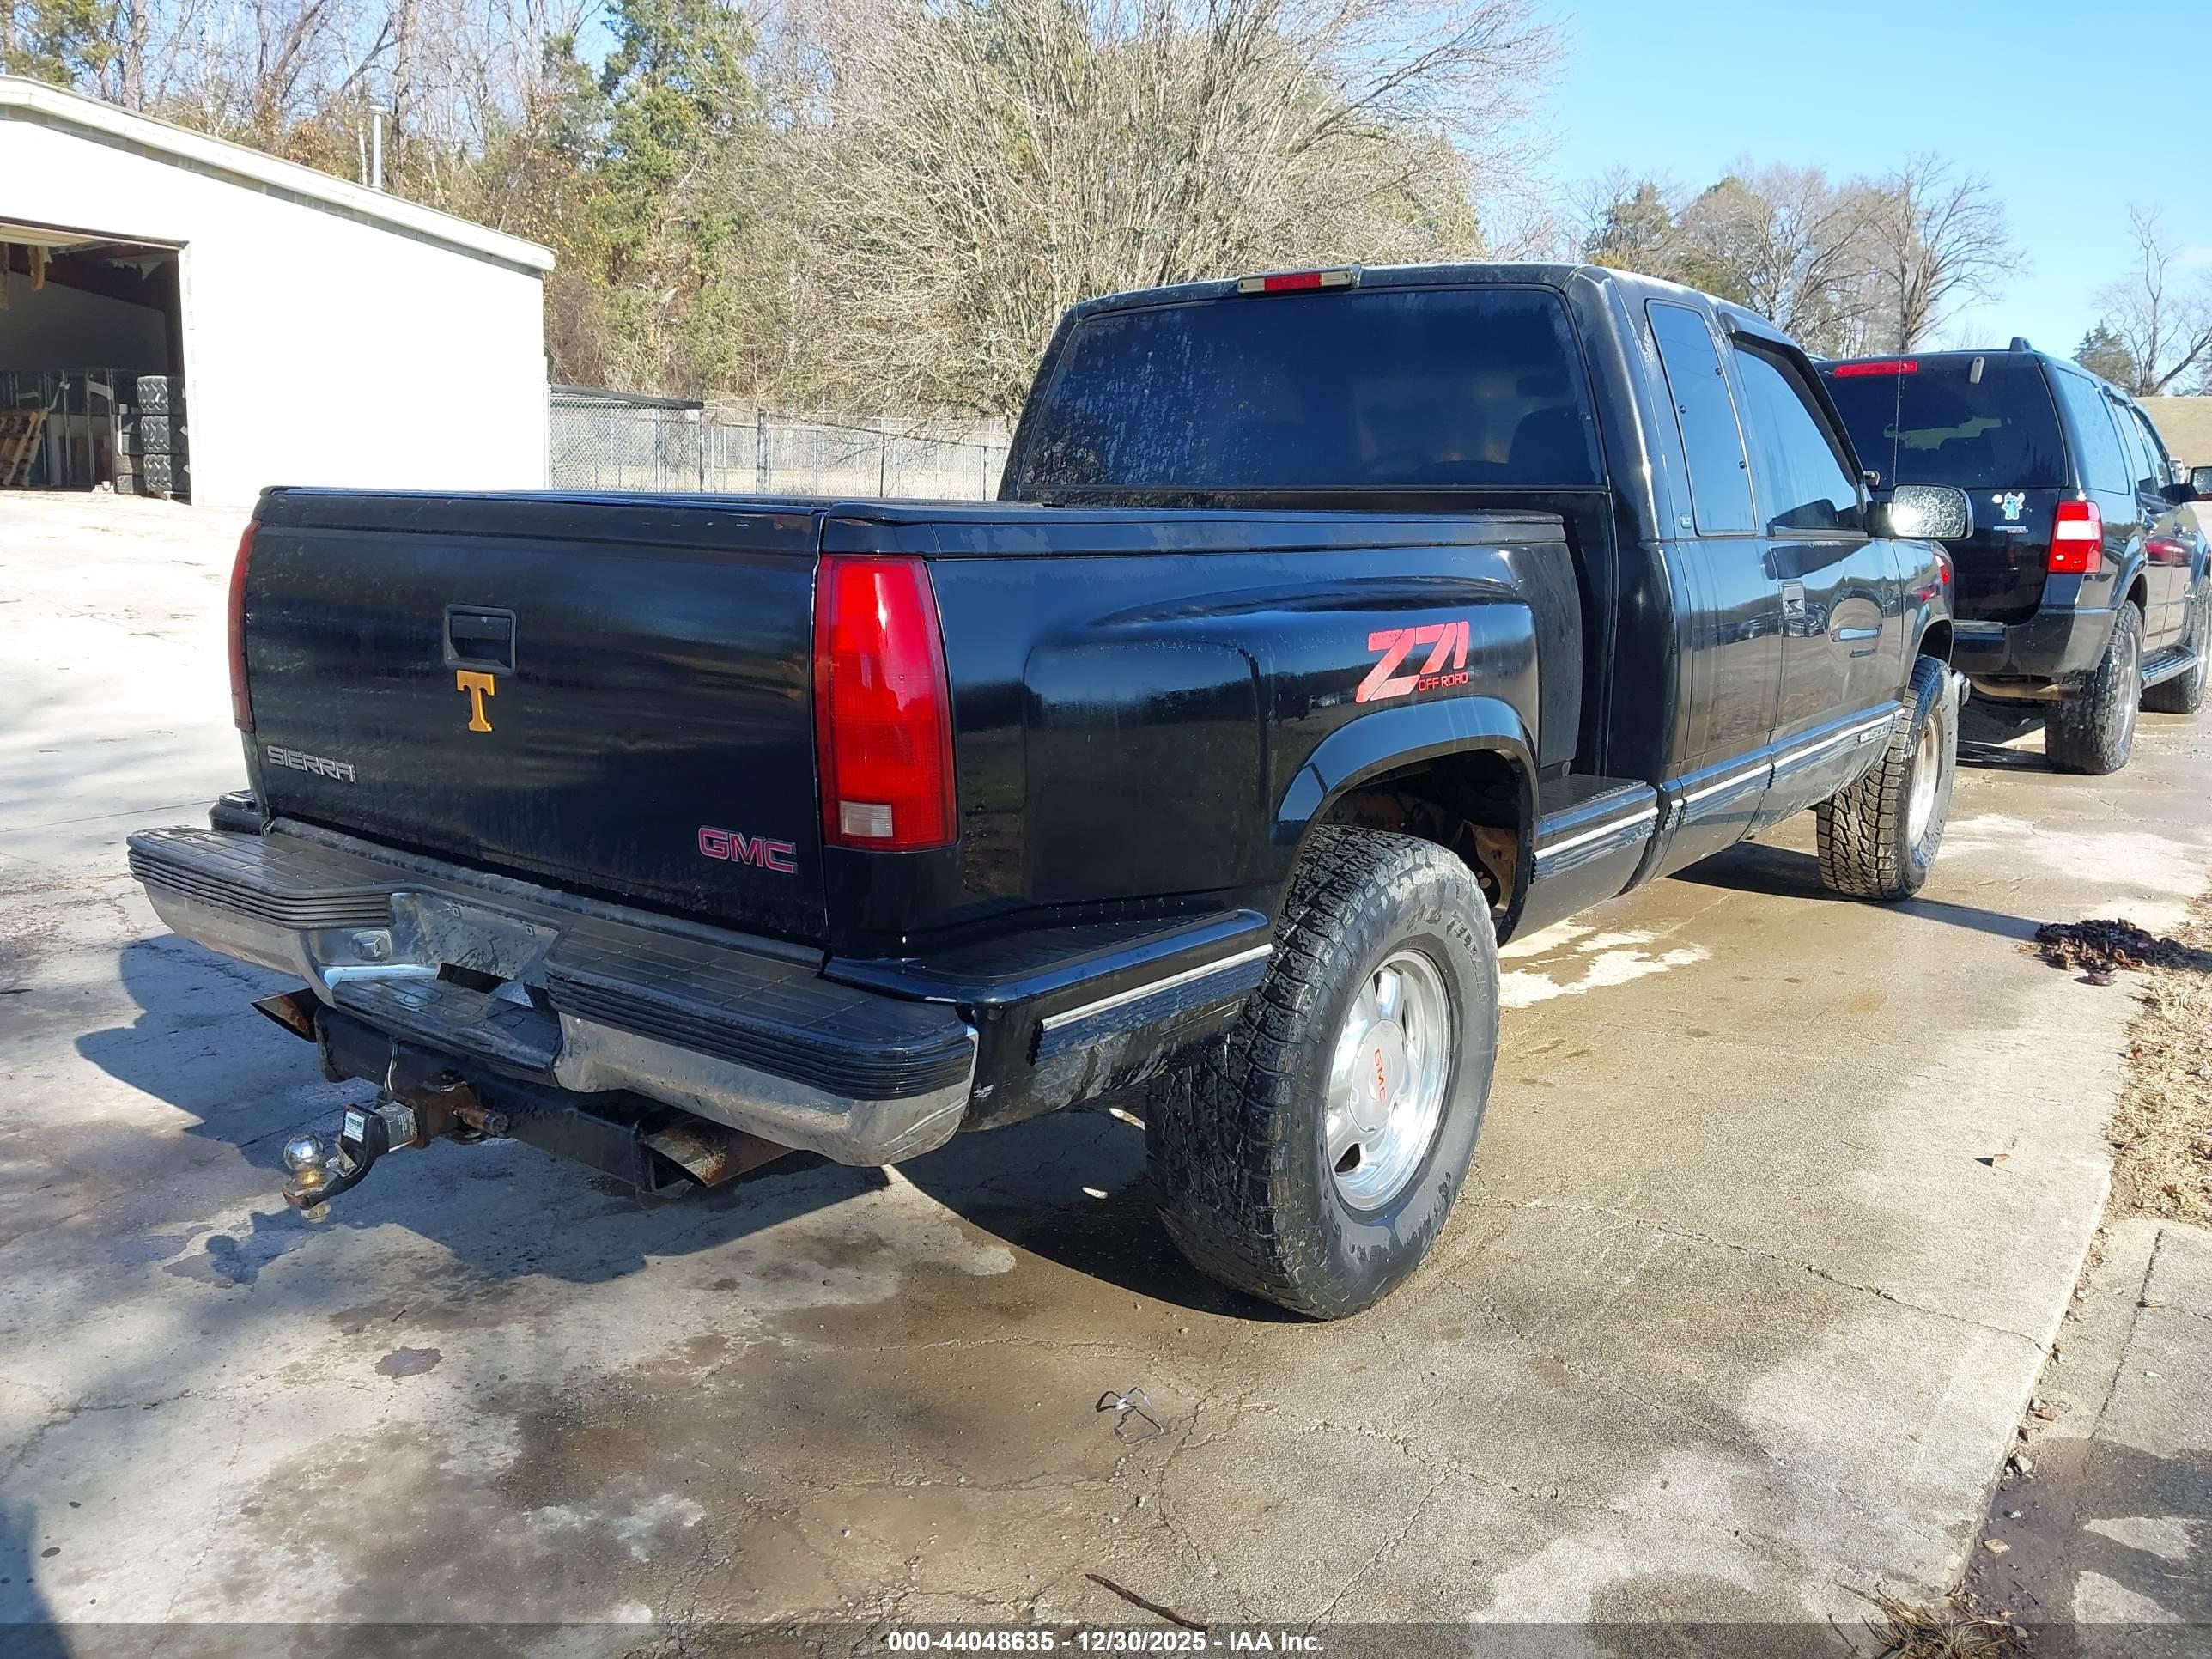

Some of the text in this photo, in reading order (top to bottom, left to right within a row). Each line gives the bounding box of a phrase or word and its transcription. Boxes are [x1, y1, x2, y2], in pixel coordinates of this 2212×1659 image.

[1355, 621, 1470, 703] Z71
[1419, 672, 1469, 692] OFF ROAD
[456, 670, 495, 732] T
[267, 744, 356, 784] SIERRA
[697, 825, 799, 875] GMC
